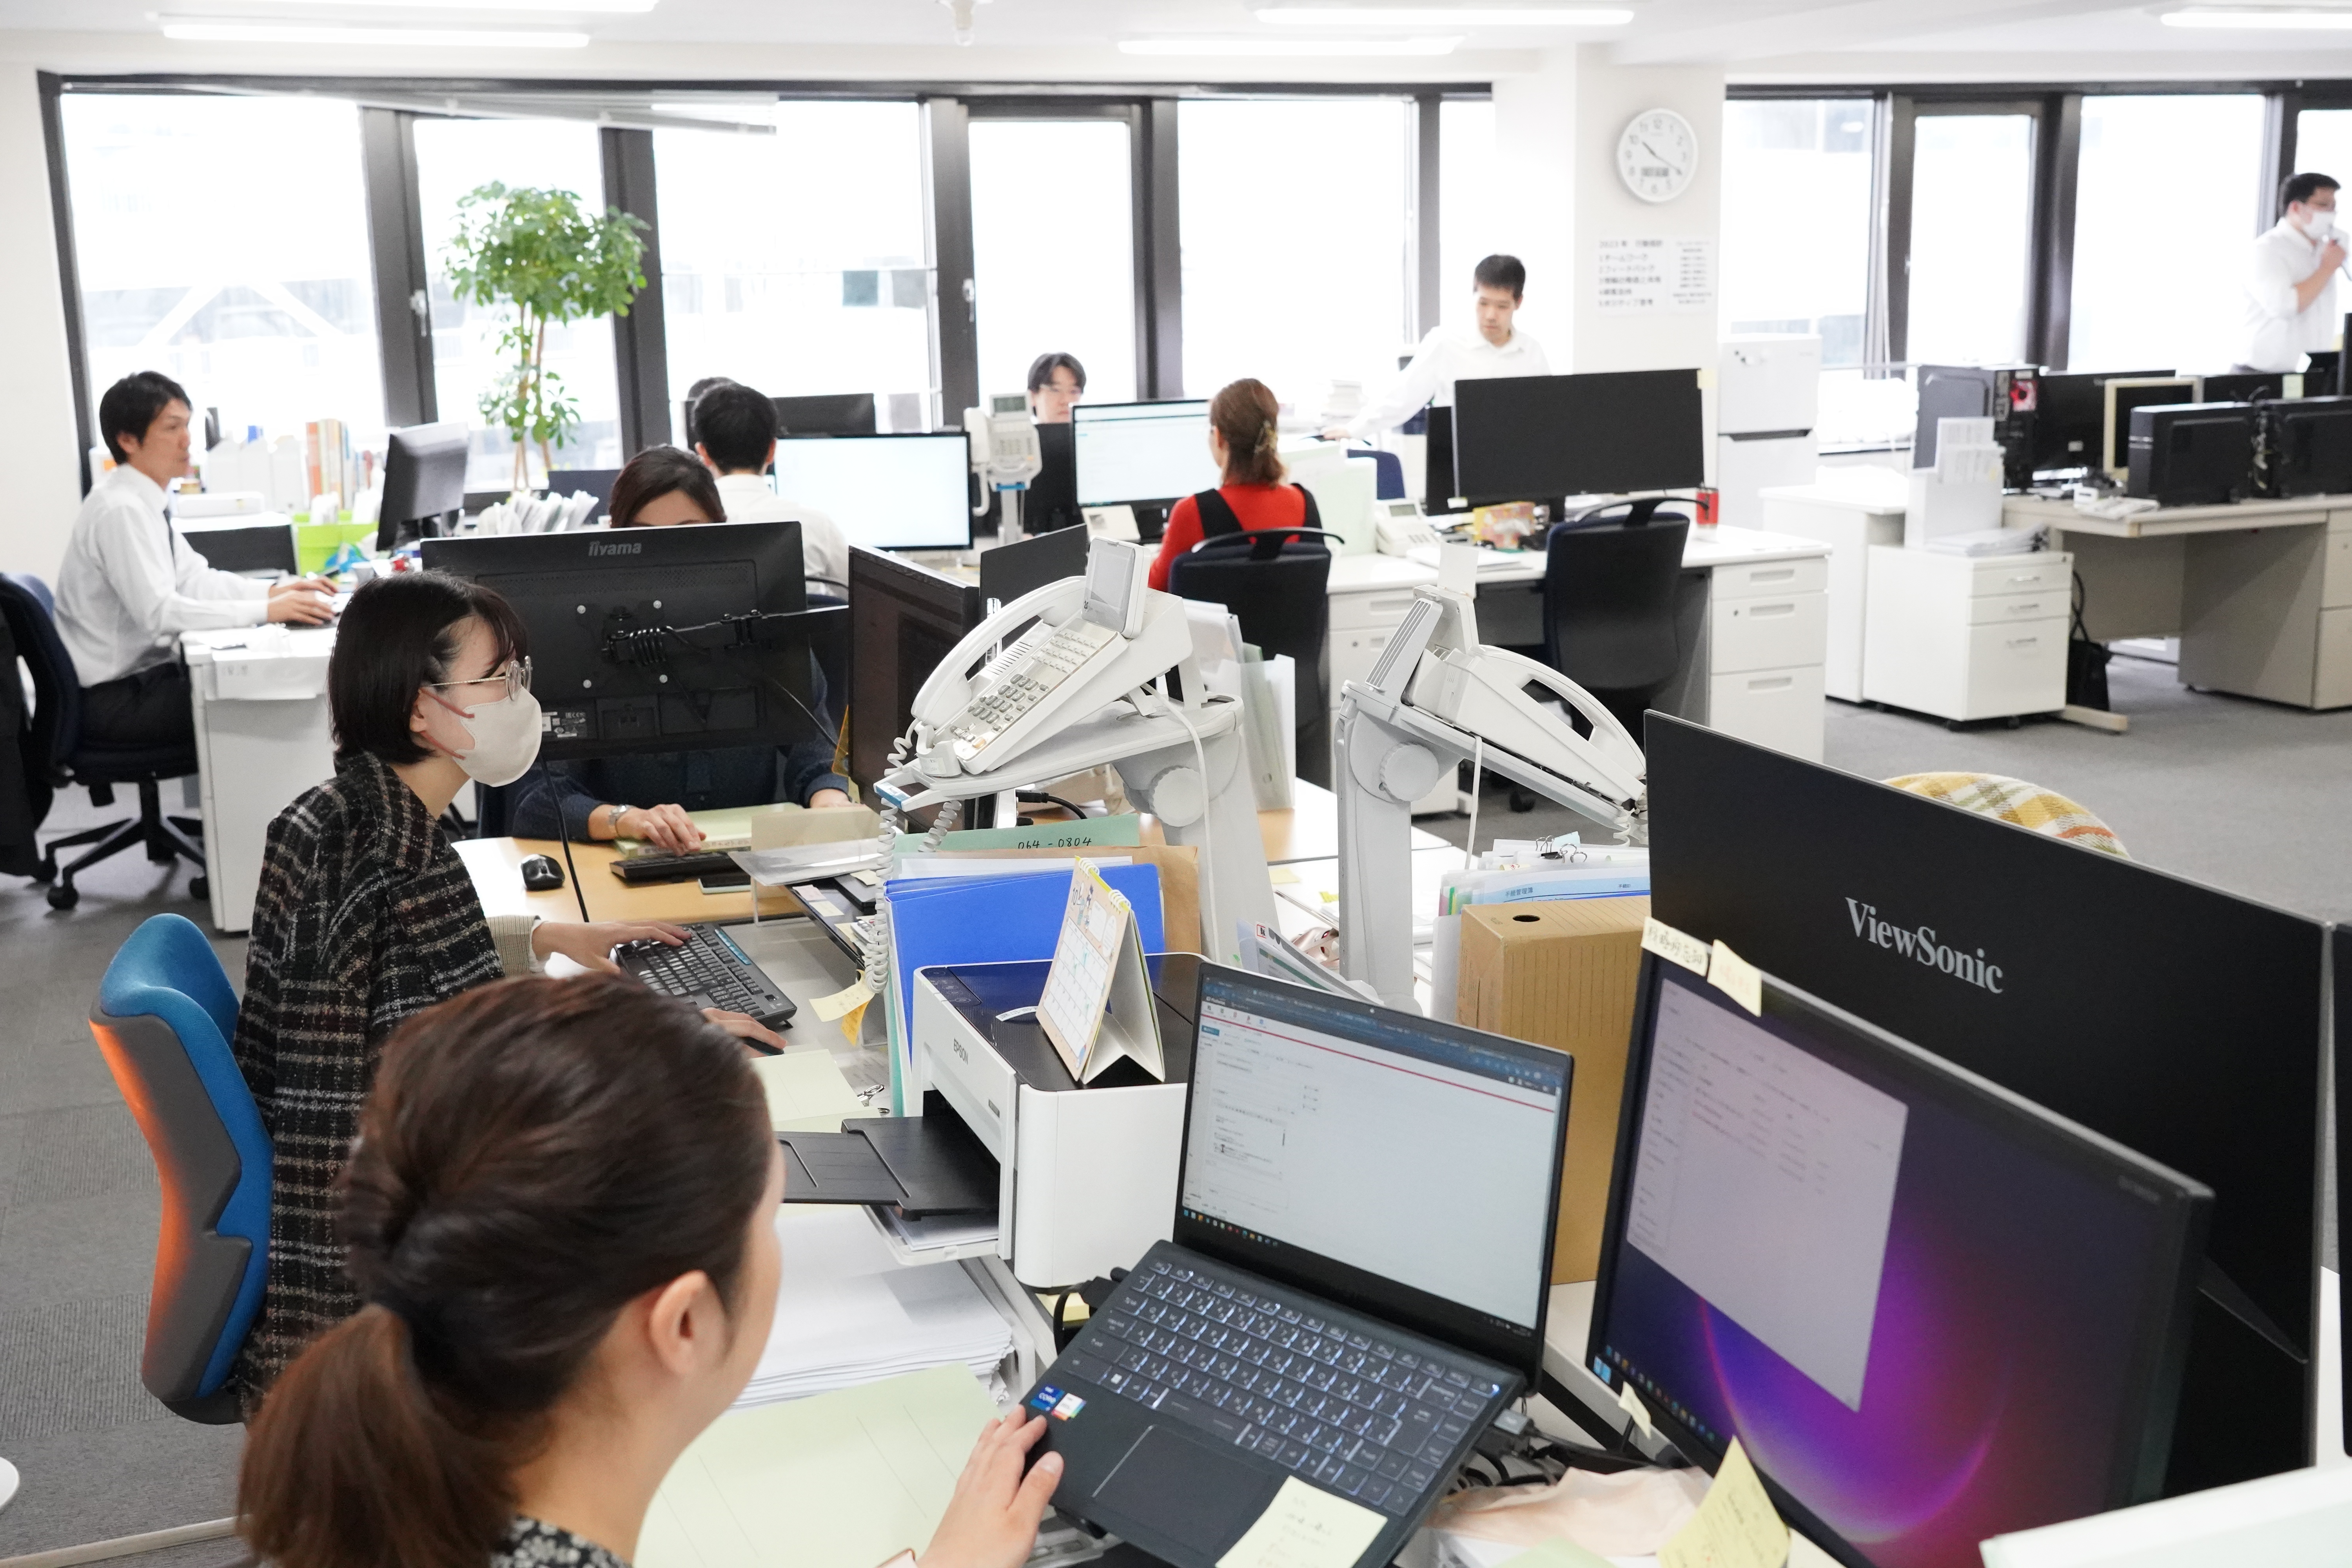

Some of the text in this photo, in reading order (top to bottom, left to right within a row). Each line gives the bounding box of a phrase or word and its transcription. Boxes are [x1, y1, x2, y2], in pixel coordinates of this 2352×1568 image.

[589, 541, 642, 556] iiyama
[1072, 887, 1078, 906] 10
[1506, 887, 1533, 897] 手続管理簿
[1845, 897, 2003, 994] ViewSonic
[953, 1038, 968, 1065] EPSON
